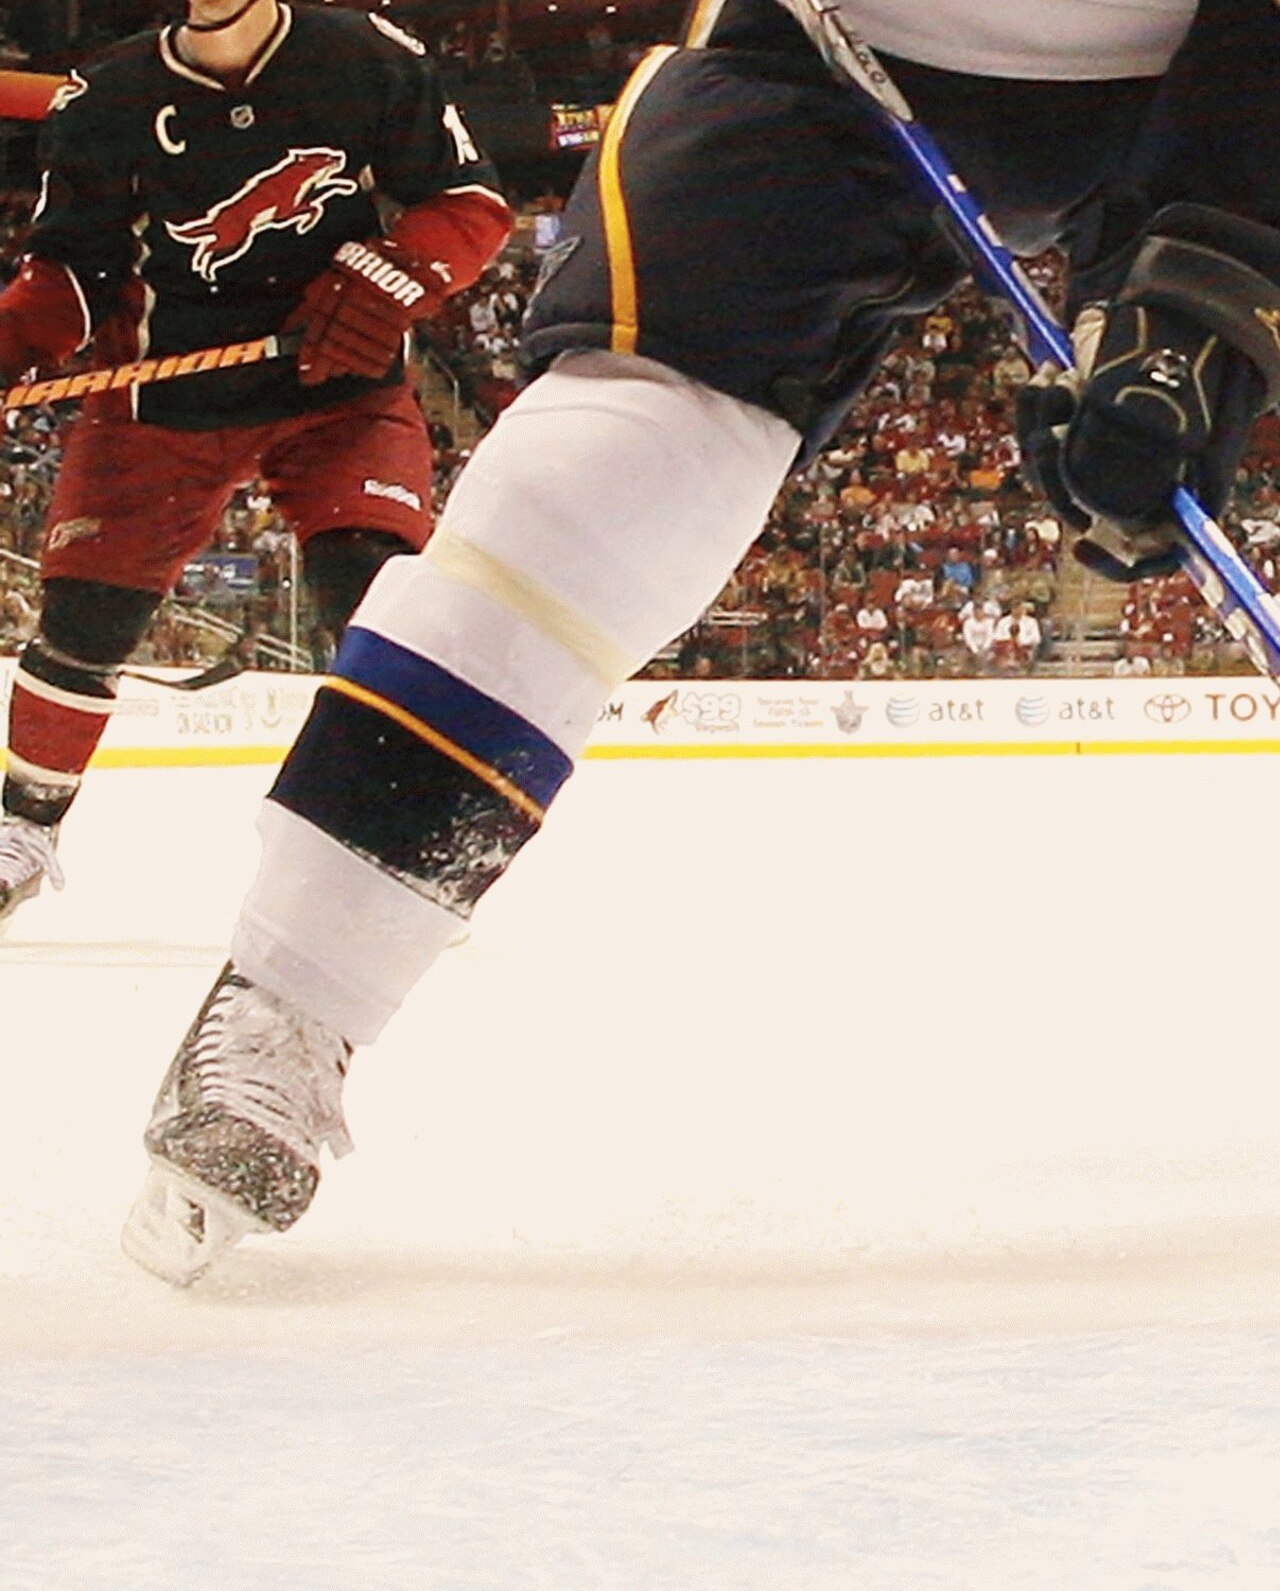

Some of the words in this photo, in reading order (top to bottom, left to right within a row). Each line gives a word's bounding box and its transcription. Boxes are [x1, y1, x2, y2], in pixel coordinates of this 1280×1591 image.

[155, 105, 186, 154] C
[928, 698, 985, 722] at&t
[1058, 696, 1116, 721] at&t
